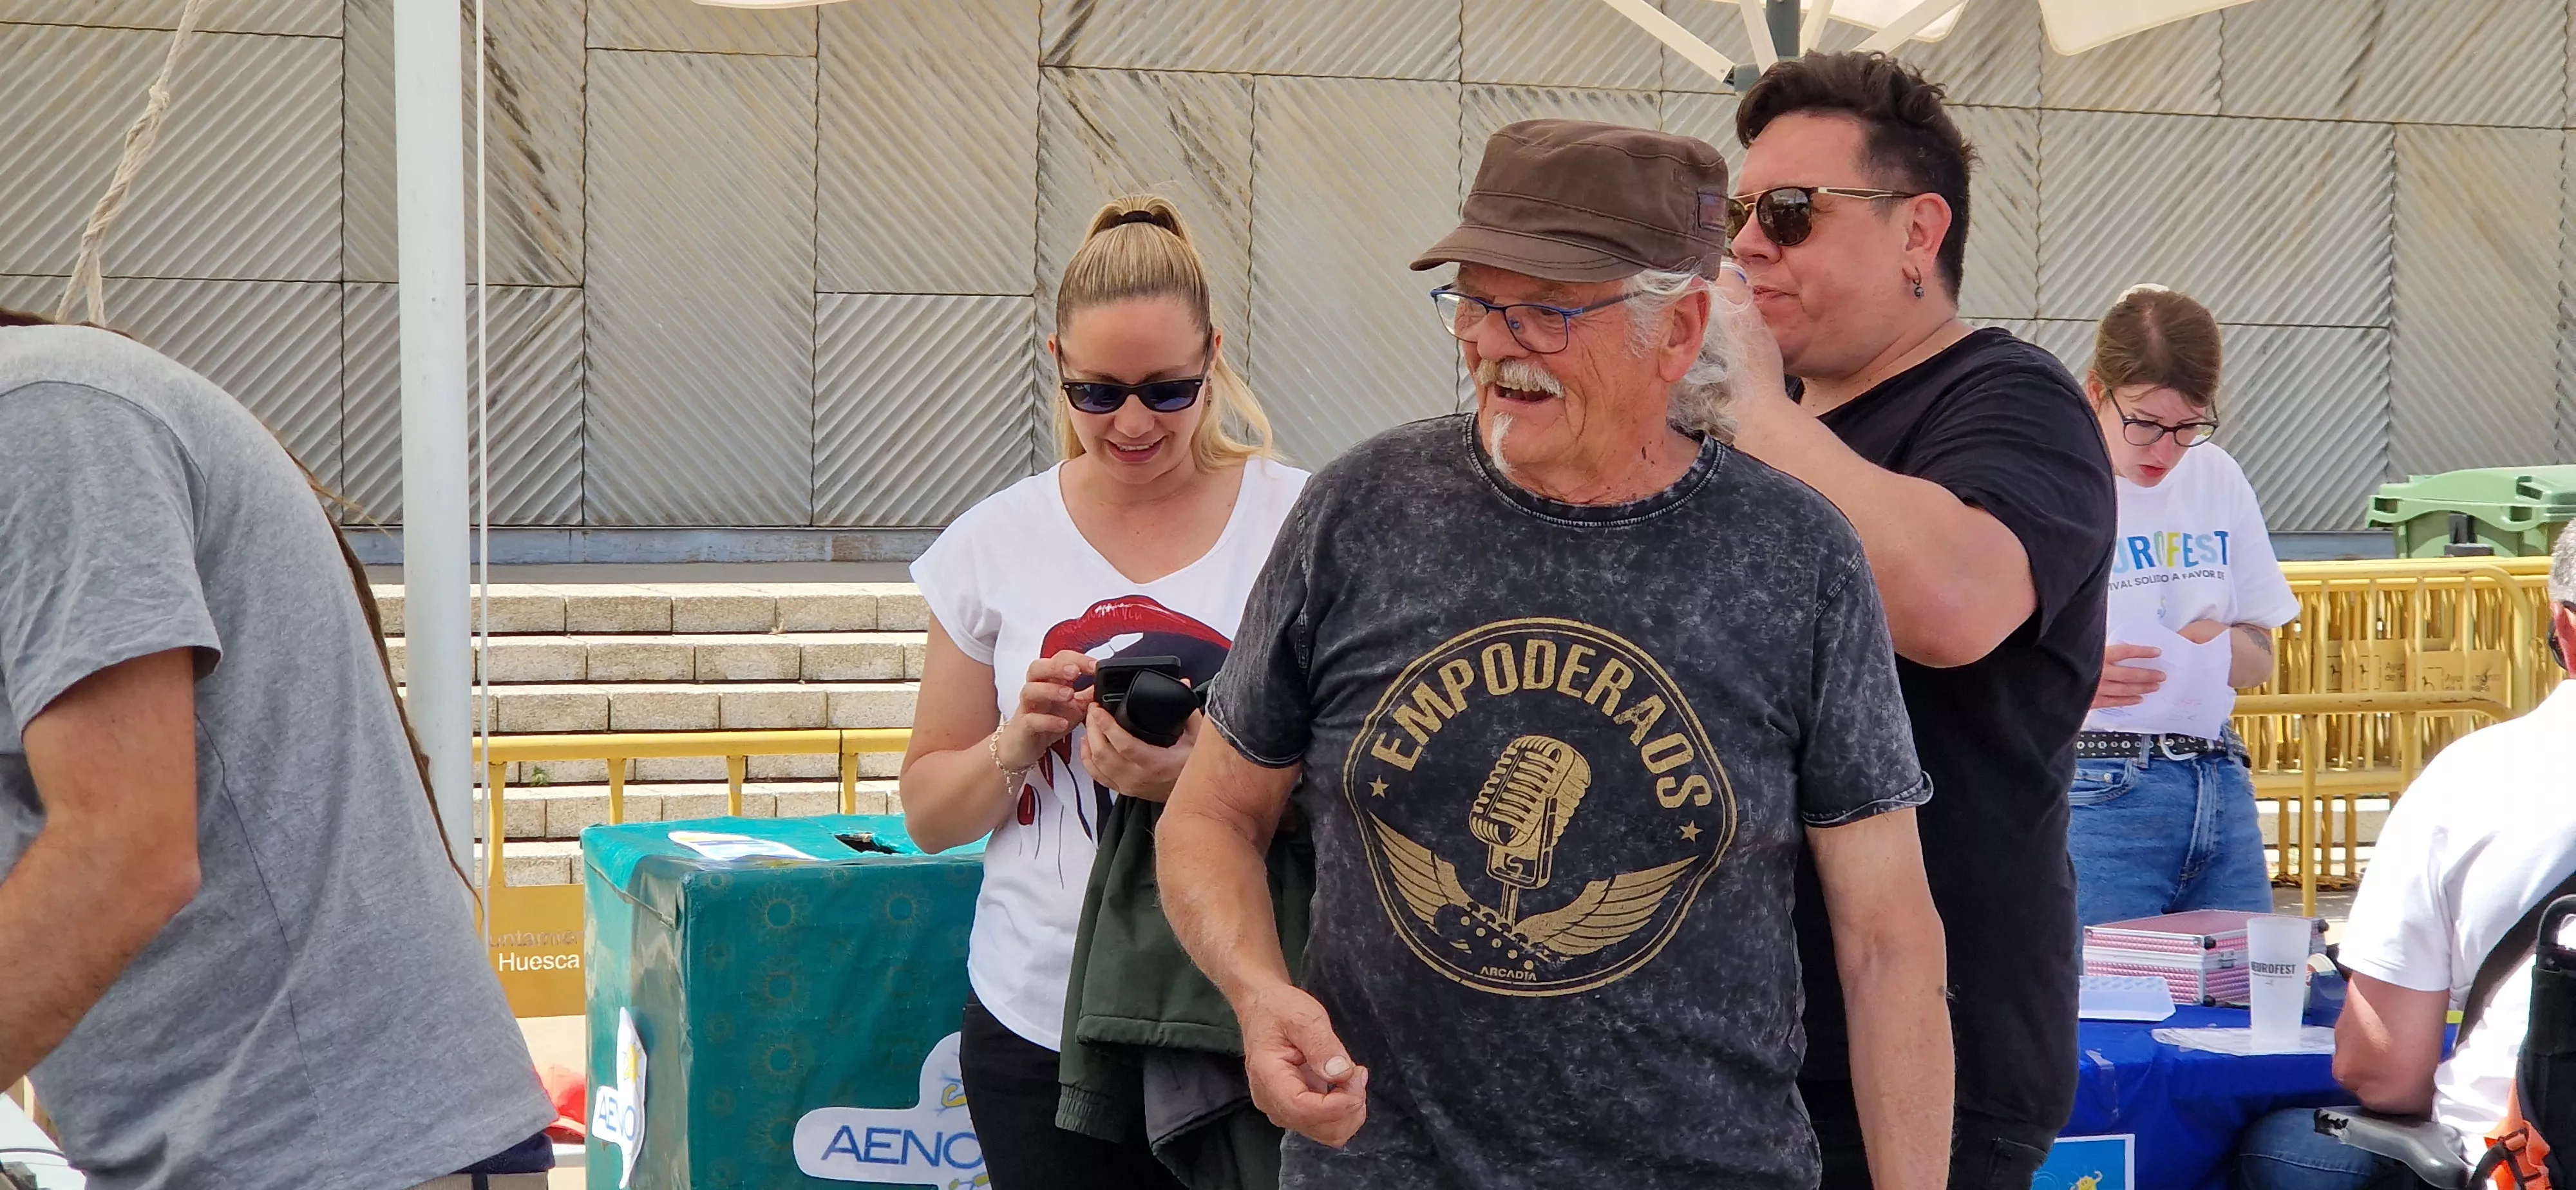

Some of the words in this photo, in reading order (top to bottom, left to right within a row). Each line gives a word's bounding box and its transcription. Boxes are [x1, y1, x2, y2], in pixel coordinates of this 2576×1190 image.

[2182, 570, 2215, 579] FAVOR
[1370, 639, 1712, 809] EMPODERAOS
[498, 952, 580, 972] Huesca
[1480, 966, 1537, 981] ARCADIA
[820, 1124, 985, 1169] AENO
